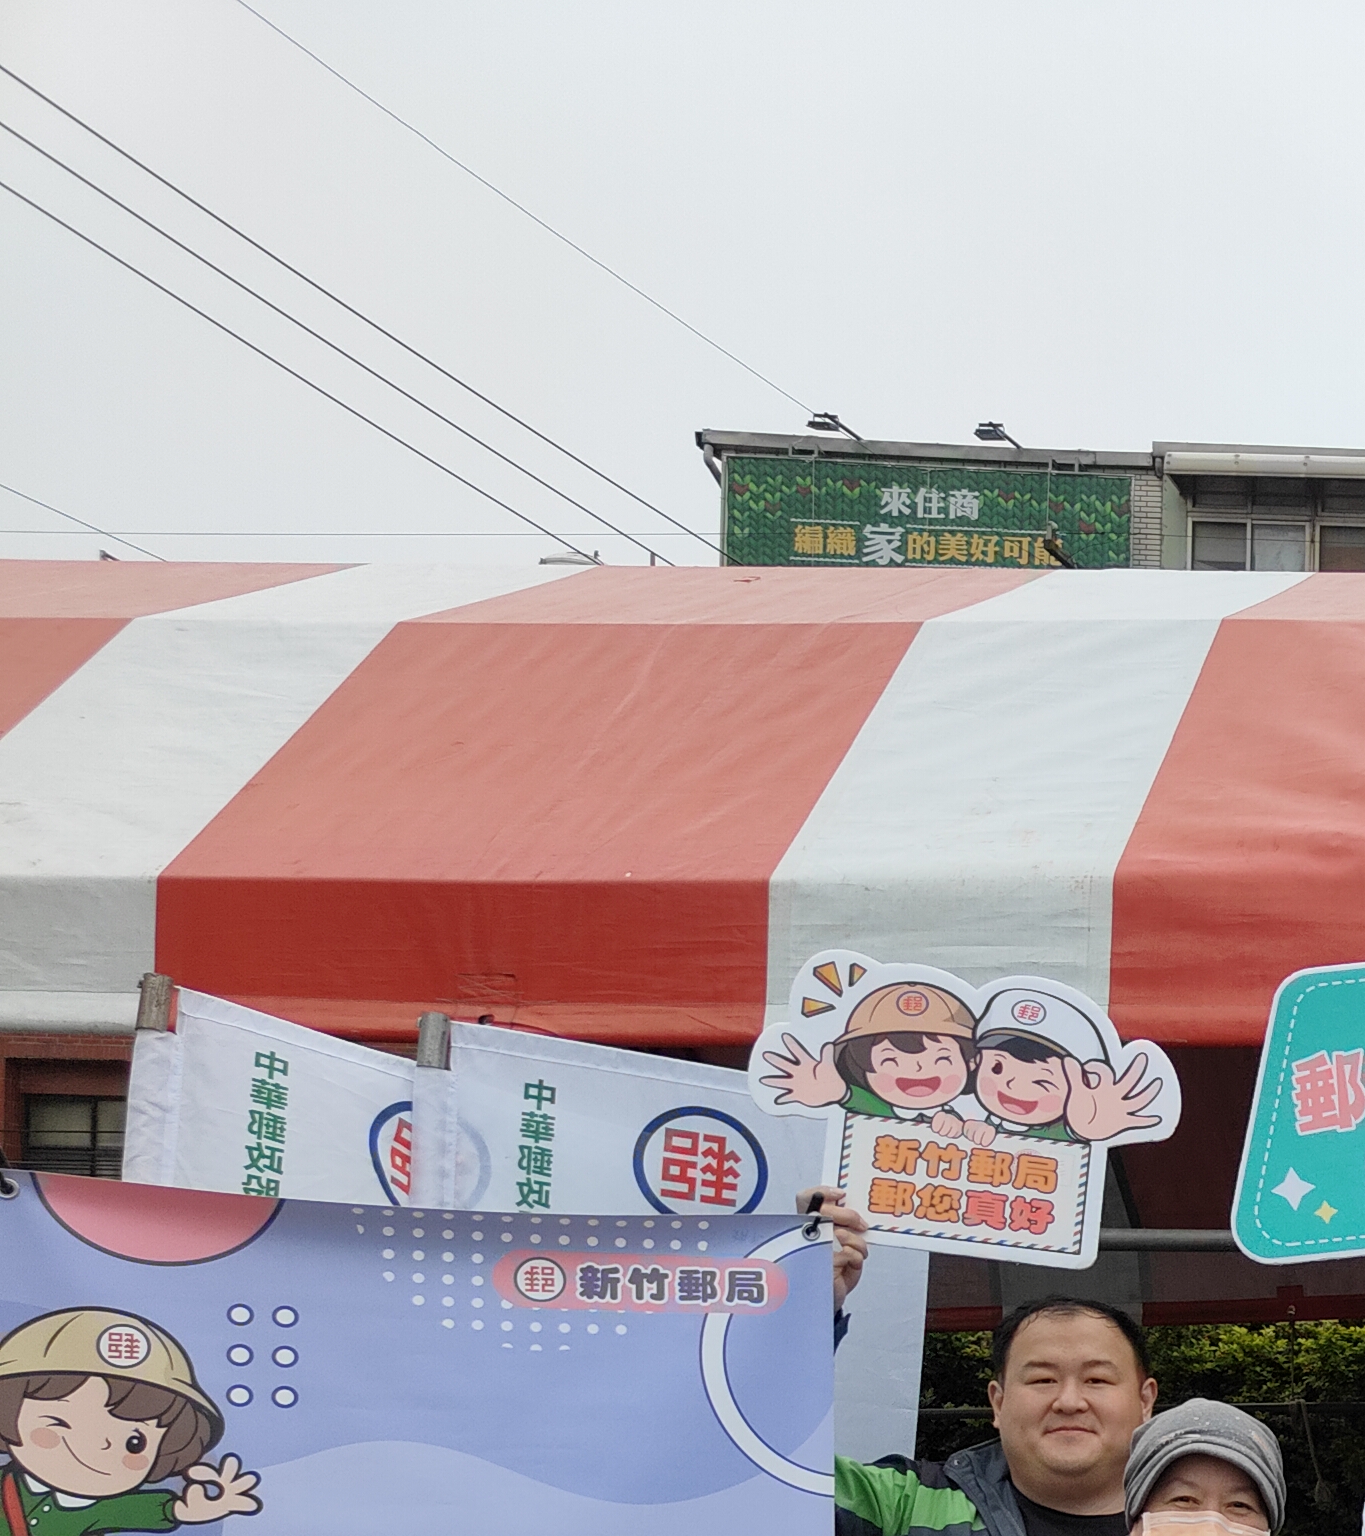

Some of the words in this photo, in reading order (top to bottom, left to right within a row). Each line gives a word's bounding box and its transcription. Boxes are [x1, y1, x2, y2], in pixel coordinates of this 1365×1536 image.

[880, 485, 980, 520] 來住商
[873, 1135, 1058, 1194] 新竹郵局
[868, 1178, 1055, 1235] 郵您真好
[577, 1264, 767, 1305] 新竹郵局
